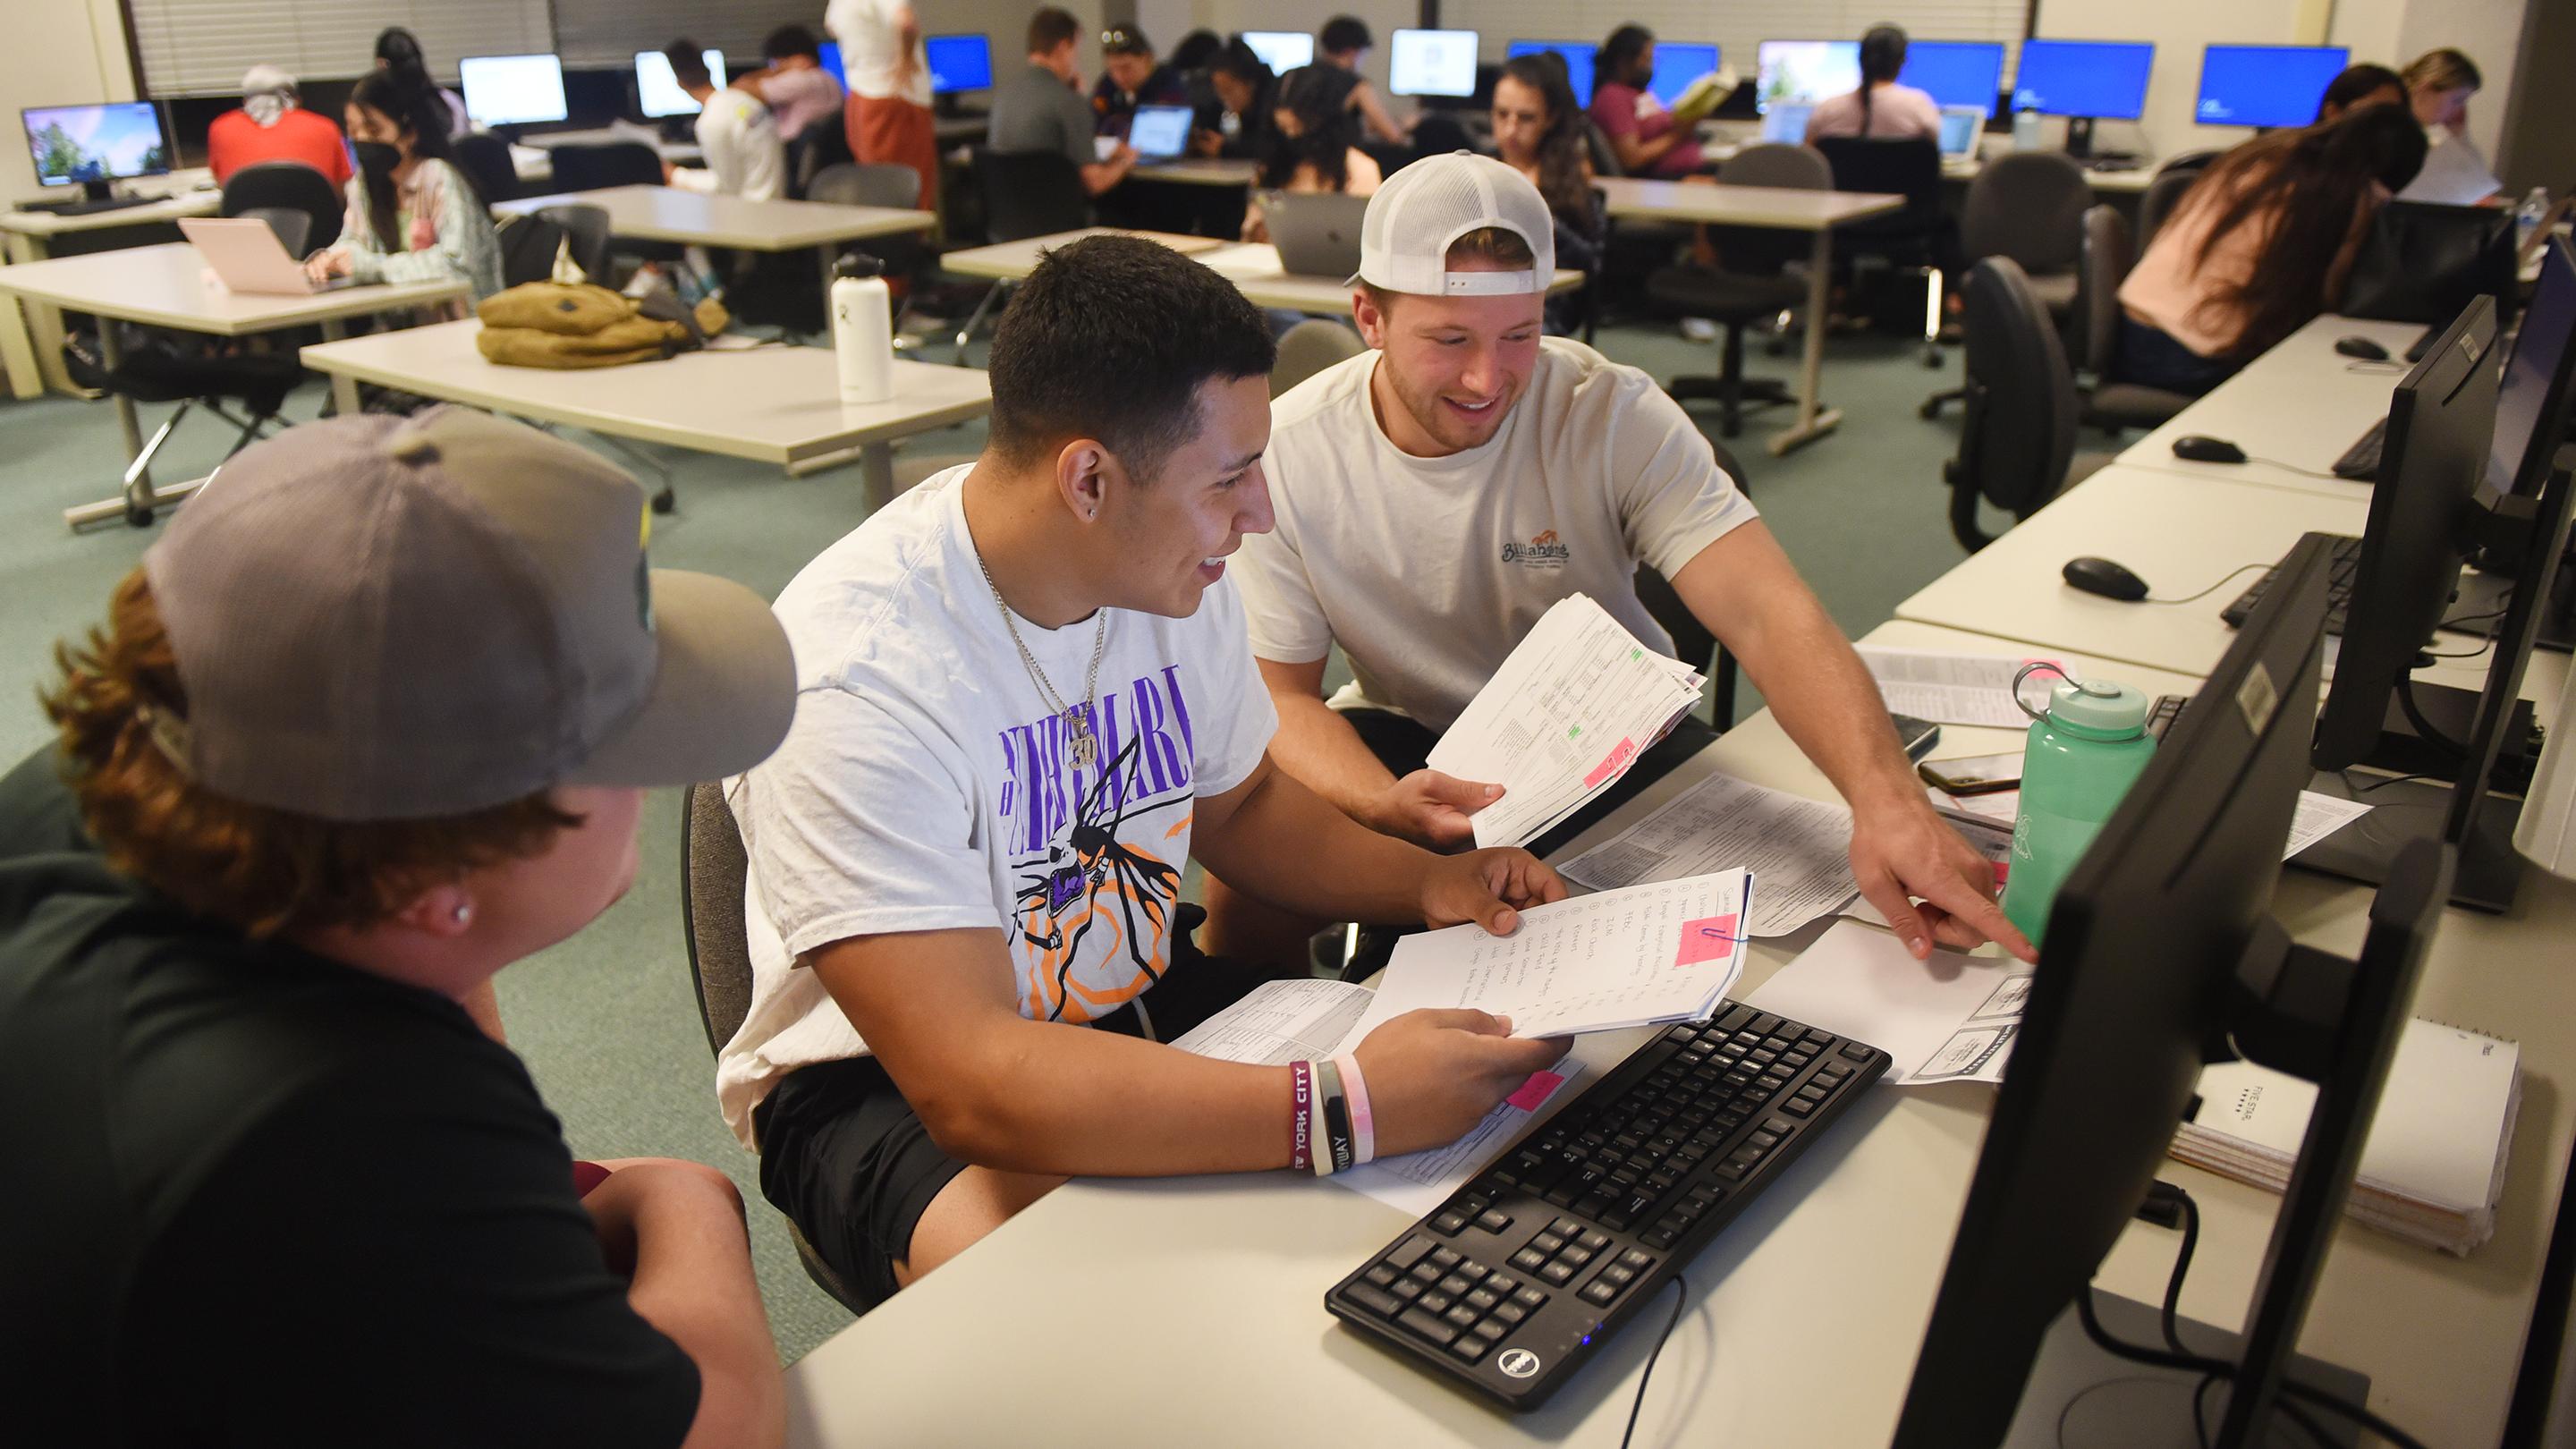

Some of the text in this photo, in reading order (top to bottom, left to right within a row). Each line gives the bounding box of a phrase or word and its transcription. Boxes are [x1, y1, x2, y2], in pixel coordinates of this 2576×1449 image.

[1068, 733, 1098, 771] 30
[2250, 1085, 2264, 1101] FIVE
[1294, 1067, 1308, 1169] EW YORK CITY
